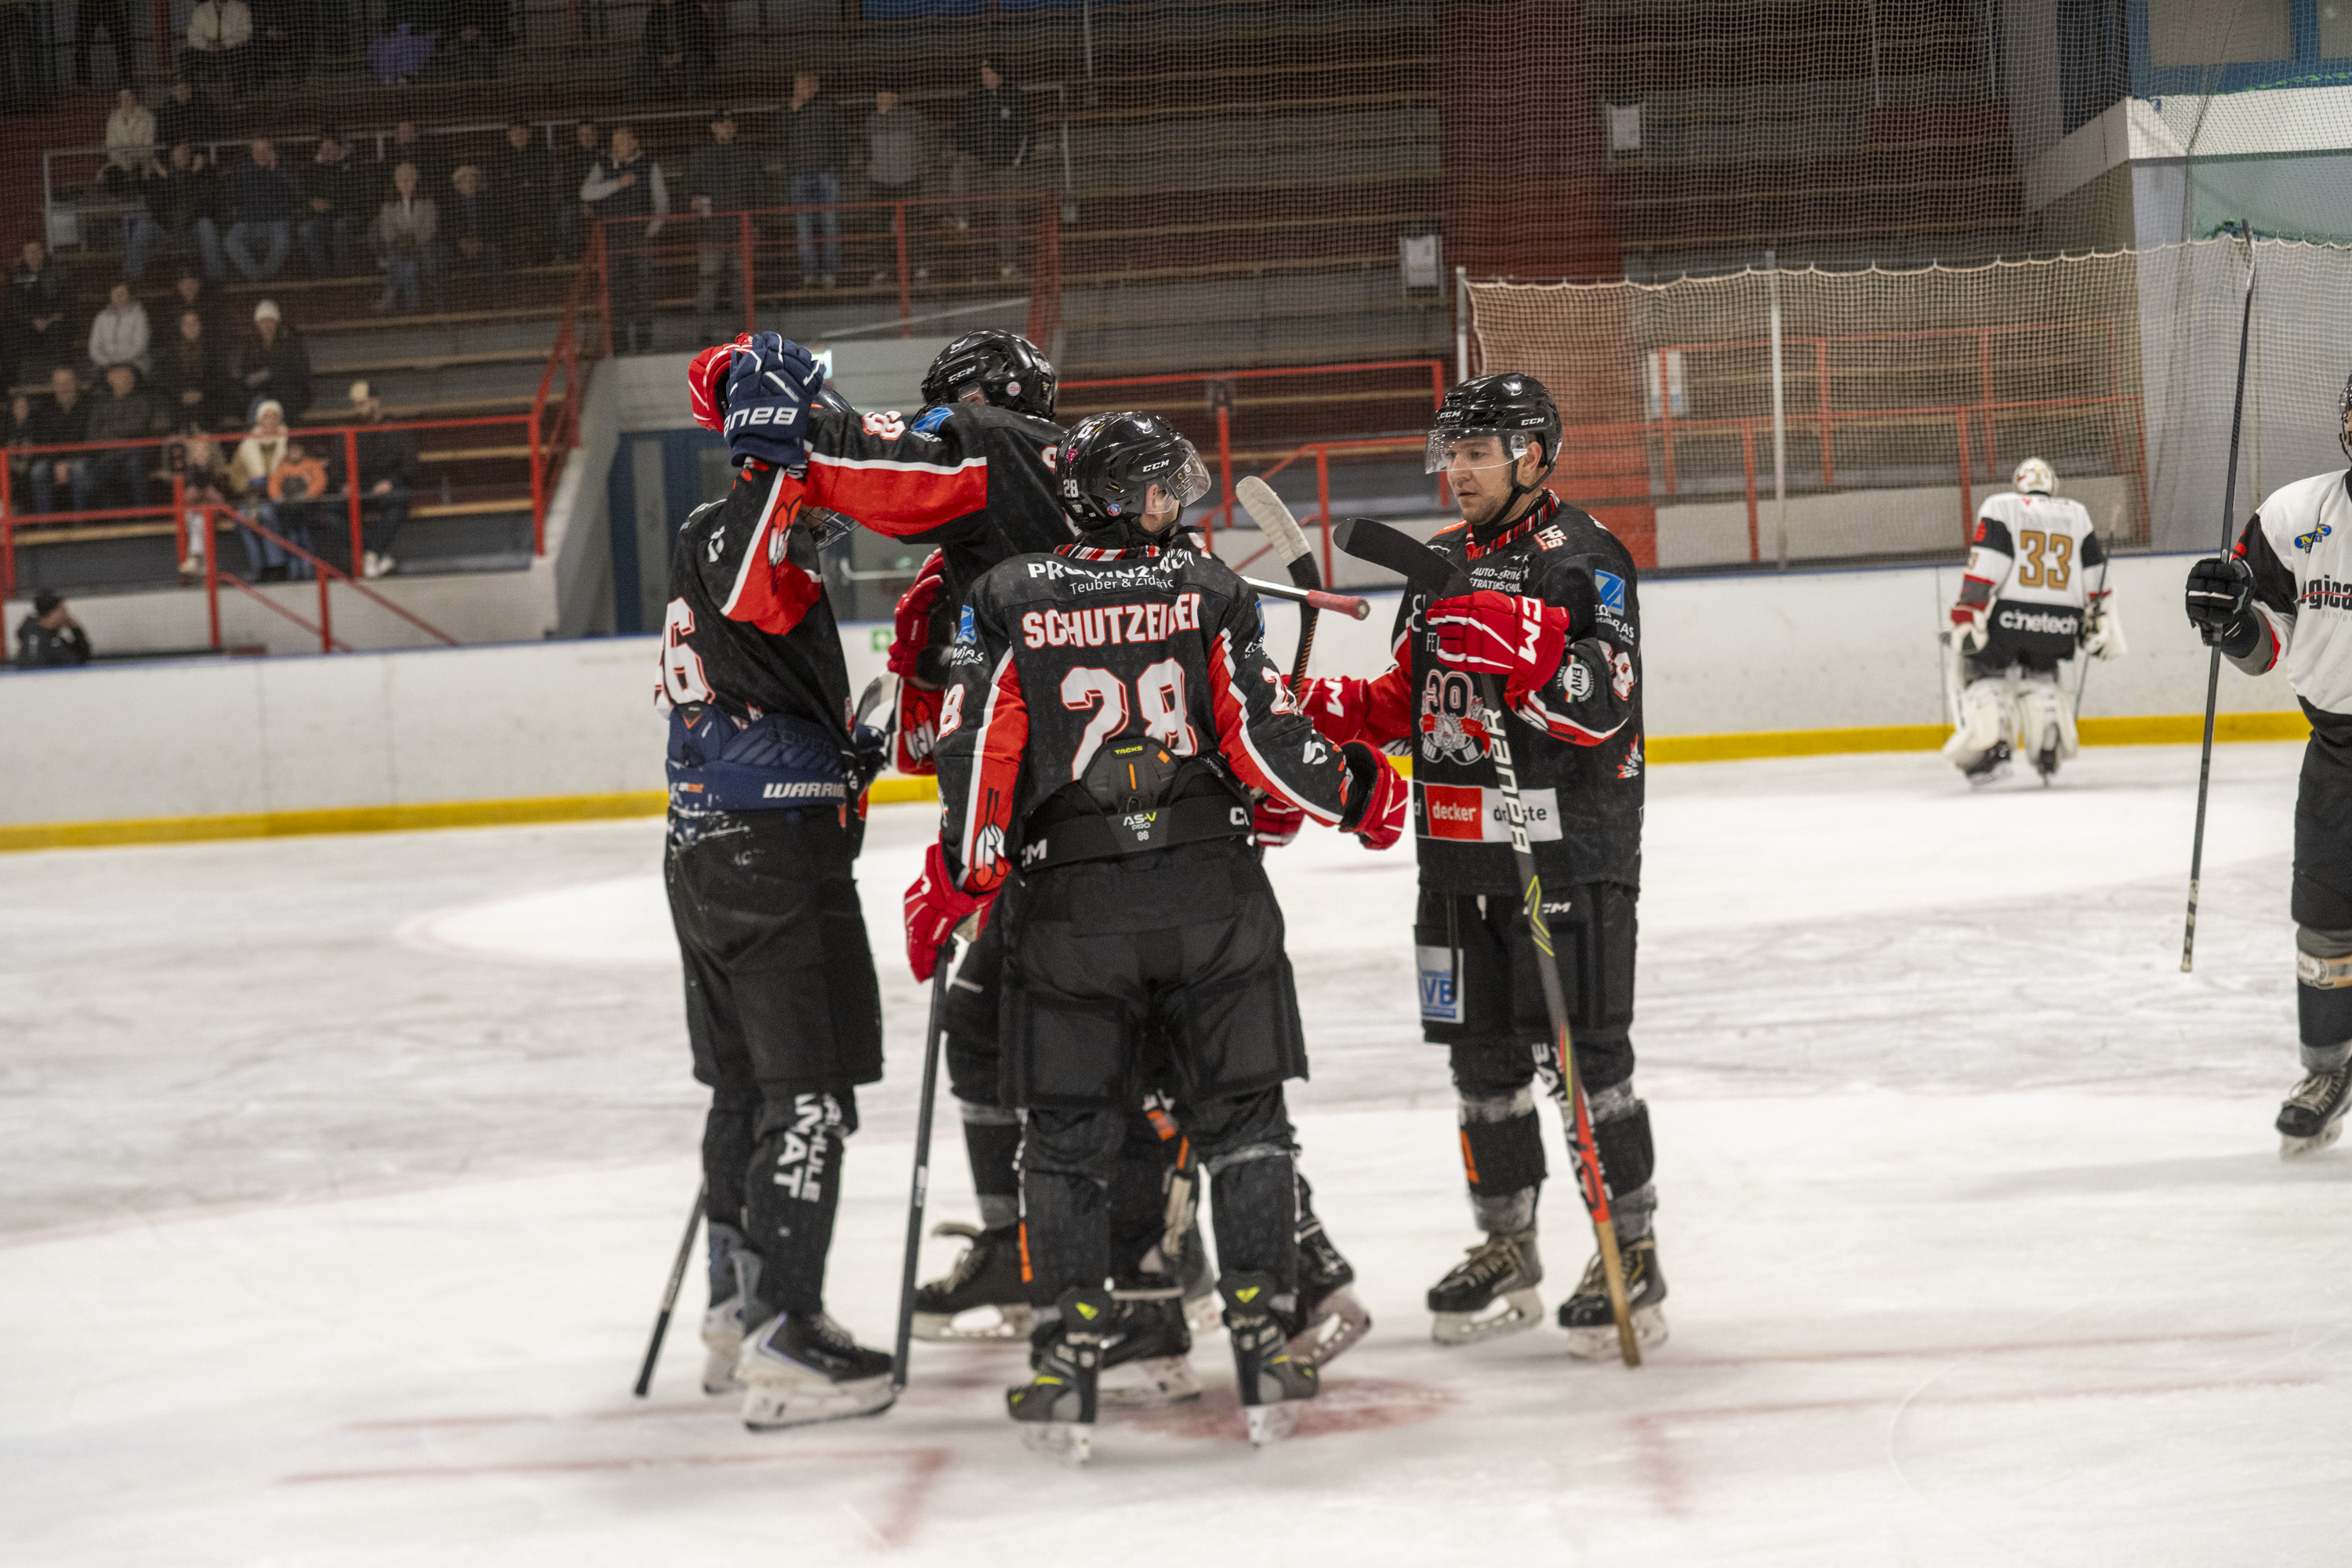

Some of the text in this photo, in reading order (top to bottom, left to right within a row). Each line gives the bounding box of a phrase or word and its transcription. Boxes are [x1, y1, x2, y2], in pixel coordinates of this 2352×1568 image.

[948, 365, 977, 383] CCM
[1440, 410, 1461, 419] CCM
[1521, 417, 1545, 426] CCM
[1142, 459, 1170, 472] CCM
[1063, 479, 1079, 498] 28
[2020, 530, 2073, 589] 33
[1069, 579, 1118, 595] Teuber
[1121, 578, 1132, 588] &
[1060, 657, 1199, 782] 28
[1114, 746, 1143, 755] TACKS
[1483, 707, 1532, 855] BAUER
[1123, 811, 1157, 827] AS-V
[1432, 800, 1477, 822] decker
[1131, 821, 1152, 831] PRO
